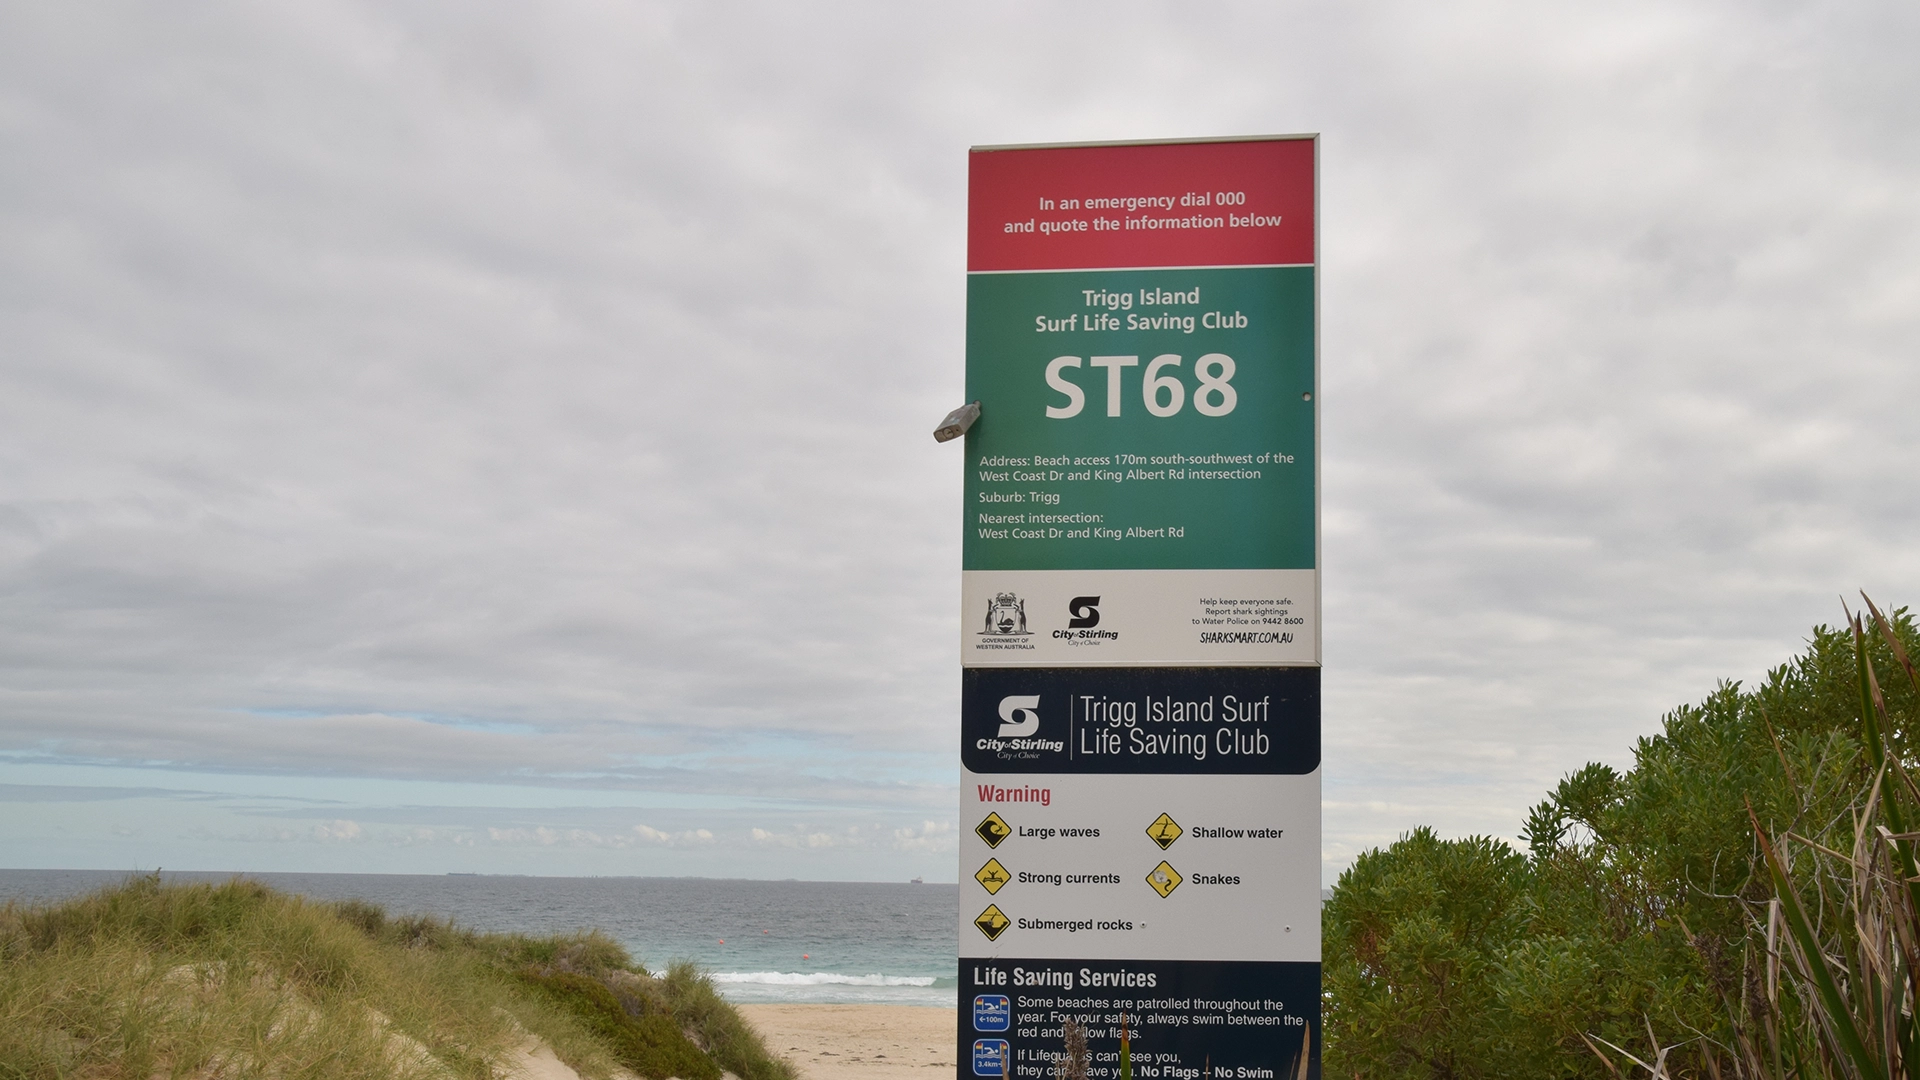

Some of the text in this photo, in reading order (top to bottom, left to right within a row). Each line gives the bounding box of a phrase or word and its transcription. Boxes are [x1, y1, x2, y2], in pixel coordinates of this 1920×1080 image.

[1040, 192, 1245, 211] In an emergency dial 000
[1004, 214, 1281, 235] and quote the information below
[1082, 288, 1199, 311] Trigg Island
[1036, 311, 1248, 334] Surf Life Saving Club
[1044, 353, 1238, 419] ST68
[980, 453, 1294, 467] Address: Beach access 170m south-southwest of the
[979, 469, 1261, 483] West Coast Dr and King Albert Rd intersection
[979, 492, 1060, 505] Suburb: Trigg
[979, 513, 1103, 524] Nearest intersection:
[979, 527, 1184, 540] West Coast Dr and King Albert Rd
[1200, 598, 1217, 606] Help
[1220, 598, 1238, 606] keep
[1206, 608, 1230, 616] Report
[1255, 608, 1288, 616] sightings
[1200, 632, 1293, 643] SHARKSMART.COM.AU
[1081, 695, 1269, 728] Trigg Island Surf
[1081, 728, 1269, 760] Life Saving Club
[978, 785, 1051, 806] Warning
[1019, 826, 1100, 840] Large waves
[1192, 827, 1283, 839] Shallow water
[1018, 872, 1120, 886] Strong currents
[1192, 874, 1240, 885] Snakes
[1018, 919, 1133, 932] Submerged rocks
[974, 967, 1157, 990] Life Saving Services
[1018, 996, 1283, 1012] Some beaches are patrolled throughout the
[1017, 1011, 1303, 1026] year. For your safety, always swim between the
[1017, 1027, 1037, 1037] red
[1041, 1027, 1063, 1037] and
[1018, 1049, 1181, 1064] If Lifeguas can' see you,
[1017, 1065, 1043, 1078] they
[1081, 1067, 1108, 1076] ave
[1141, 1066, 1159, 1077] No
[1163, 1066, 1199, 1079] Flags
[1215, 1067, 1233, 1078] No
[1237, 1067, 1273, 1078] Swim
